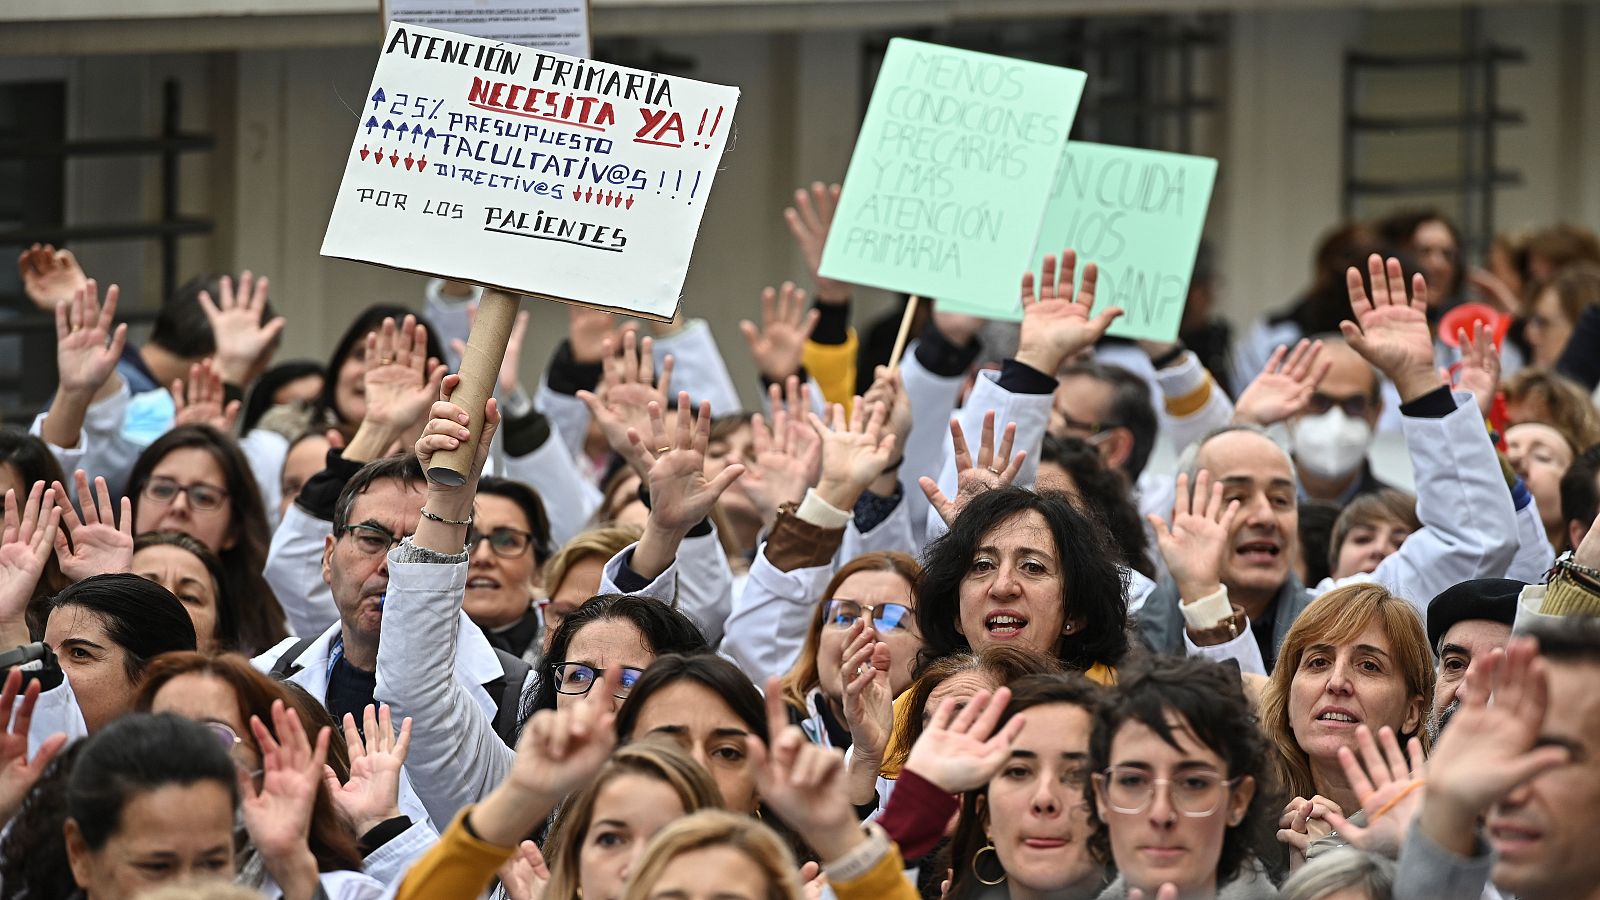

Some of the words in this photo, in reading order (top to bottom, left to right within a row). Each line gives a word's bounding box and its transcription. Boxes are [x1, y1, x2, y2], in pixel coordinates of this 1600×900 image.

[386, 28, 521, 75] ATENCIÓN
[534, 53, 672, 107] PRIMARIA
[906, 52, 1026, 101] MENOS
[389, 93, 445, 120] 25%
[448, 112, 613, 155] PRESUPUESTO
[468, 77, 616, 126] NECESITA
[635, 108, 685, 143] YA
[886, 85, 1060, 146] CONDICIONES
[872, 157, 893, 189] Y
[876, 120, 1028, 180] PRECARIAS
[1050, 150, 1094, 200] N
[433, 163, 565, 200] DIRECTIV@S
[356, 188, 408, 211] POR
[422, 200, 464, 219] LOS
[484, 207, 628, 248] PACIENTES
[854, 192, 1004, 242] ATENCIÓN
[842, 226, 962, 278] PRIMARIA
